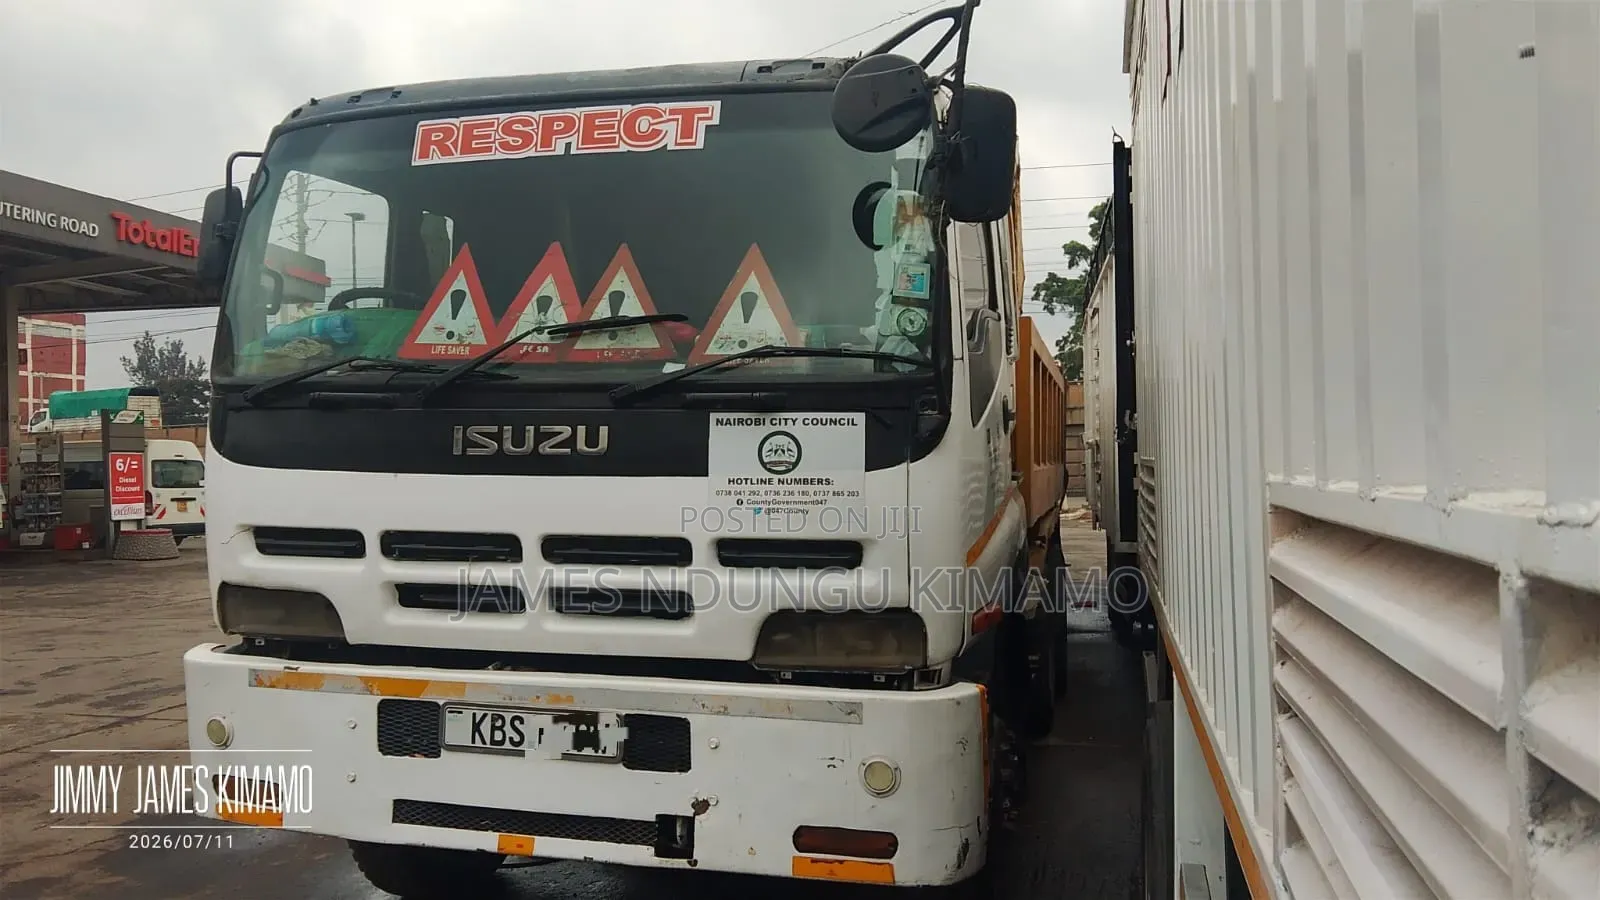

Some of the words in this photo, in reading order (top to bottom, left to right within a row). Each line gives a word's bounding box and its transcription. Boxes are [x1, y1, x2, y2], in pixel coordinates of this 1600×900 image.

[414, 104, 716, 162] RESPECT
[60, 215, 99, 237] ROAD
[431, 345, 446, 354] LIFE
[447, 346, 470, 355] SAVER
[715, 417, 766, 427] NAIROBI
[769, 417, 798, 427] CITY
[802, 417, 858, 427] COUNCIL
[452, 425, 609, 455] ISUZU
[115, 457, 139, 473] 6/=
[727, 477, 774, 486] HOTLINE
[777, 477, 834, 486] NUMBERS:
[746, 498, 828, 507] CountyGovernment047
[471, 711, 526, 748] KBS
